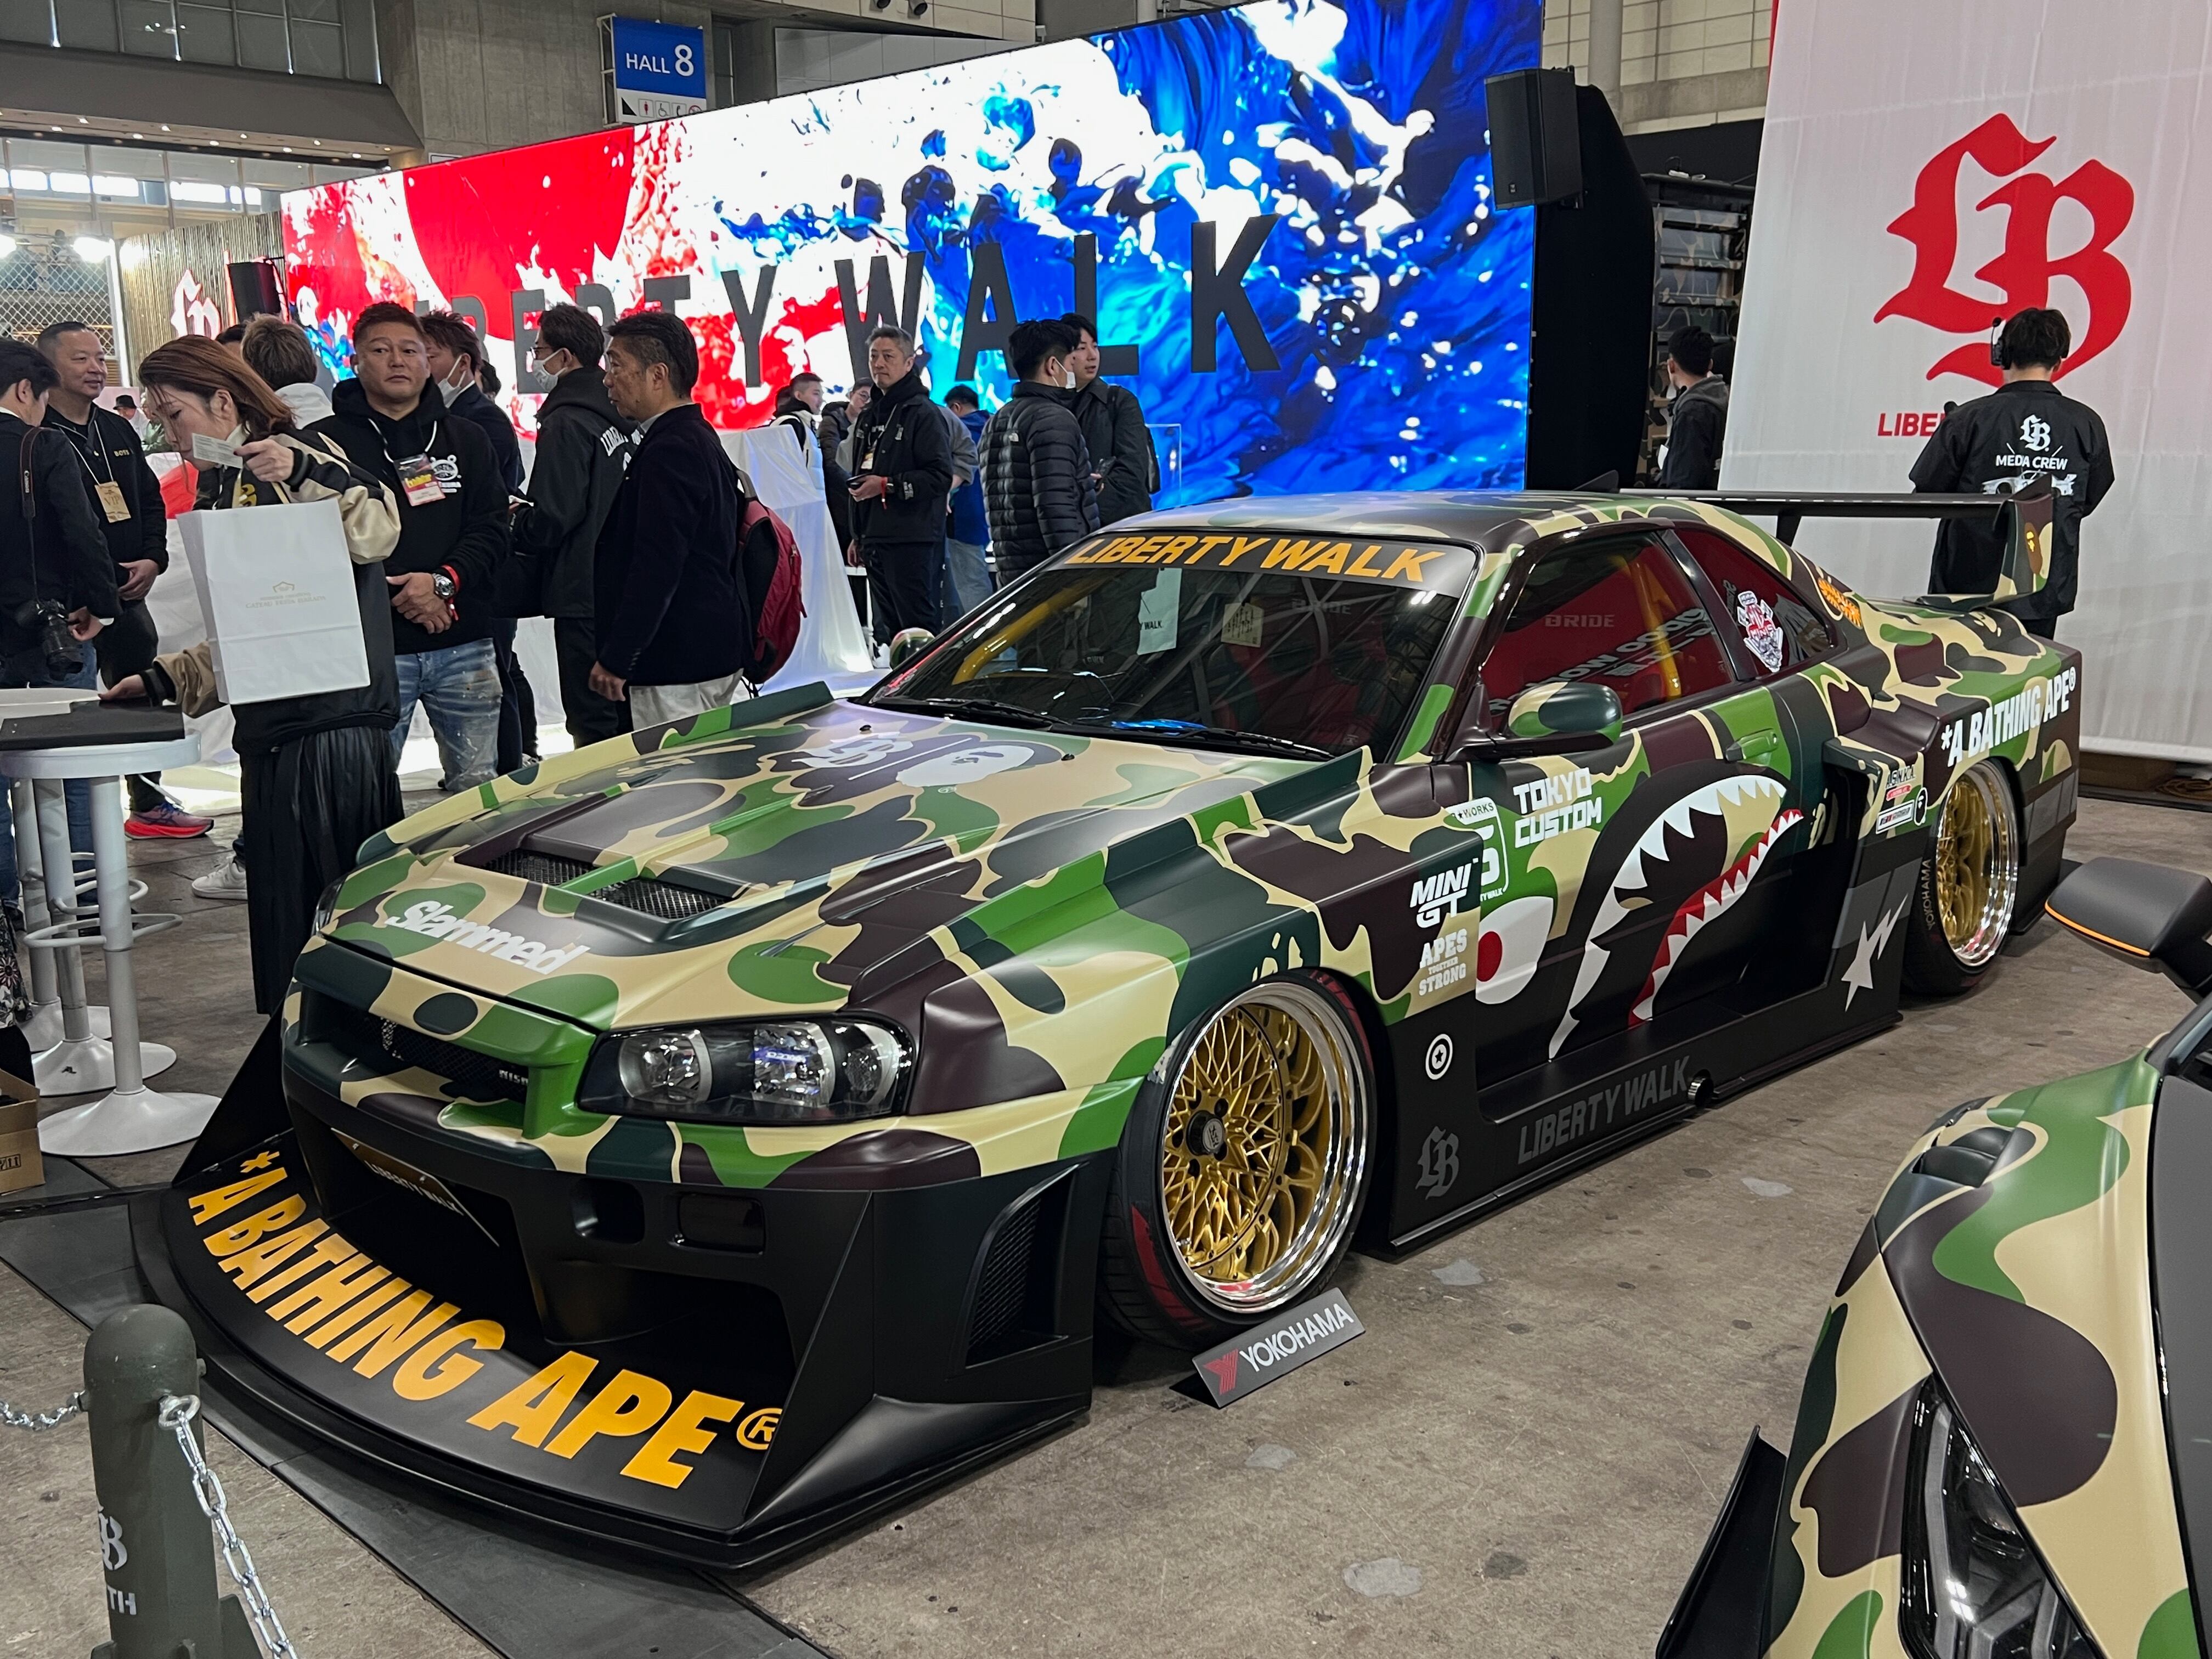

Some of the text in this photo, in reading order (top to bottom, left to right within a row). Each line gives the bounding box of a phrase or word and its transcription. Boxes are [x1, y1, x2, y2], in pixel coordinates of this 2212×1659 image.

[626, 44, 694, 76] HALL 8
[834, 212, 1281, 380] WALK
[1877, 413, 1947, 436] LIBE
[2032, 456, 2068, 470] CREW
[104, 495, 120, 505] VIP
[1064, 535, 1446, 583] LIBERTY WALK
[1545, 614, 1615, 628] BRIDE
[1968, 685, 2041, 758] BATHING
[1513, 767, 1592, 815] TOKYO
[1515, 797, 1602, 848] CUSTOM
[1410, 863, 1471, 908] MINI
[1417, 889, 1468, 928] GT
[1921, 859, 1936, 931] YOKOHAMA
[384, 900, 591, 975] Slammed
[1419, 928, 1468, 969] APES
[1419, 963, 1466, 996] STRONG
[1518, 1056, 1690, 1164] LIBERTY WALK
[203, 1193, 505, 1401] BATHING
[1239, 1303, 1355, 1372] YOKOHAMA
